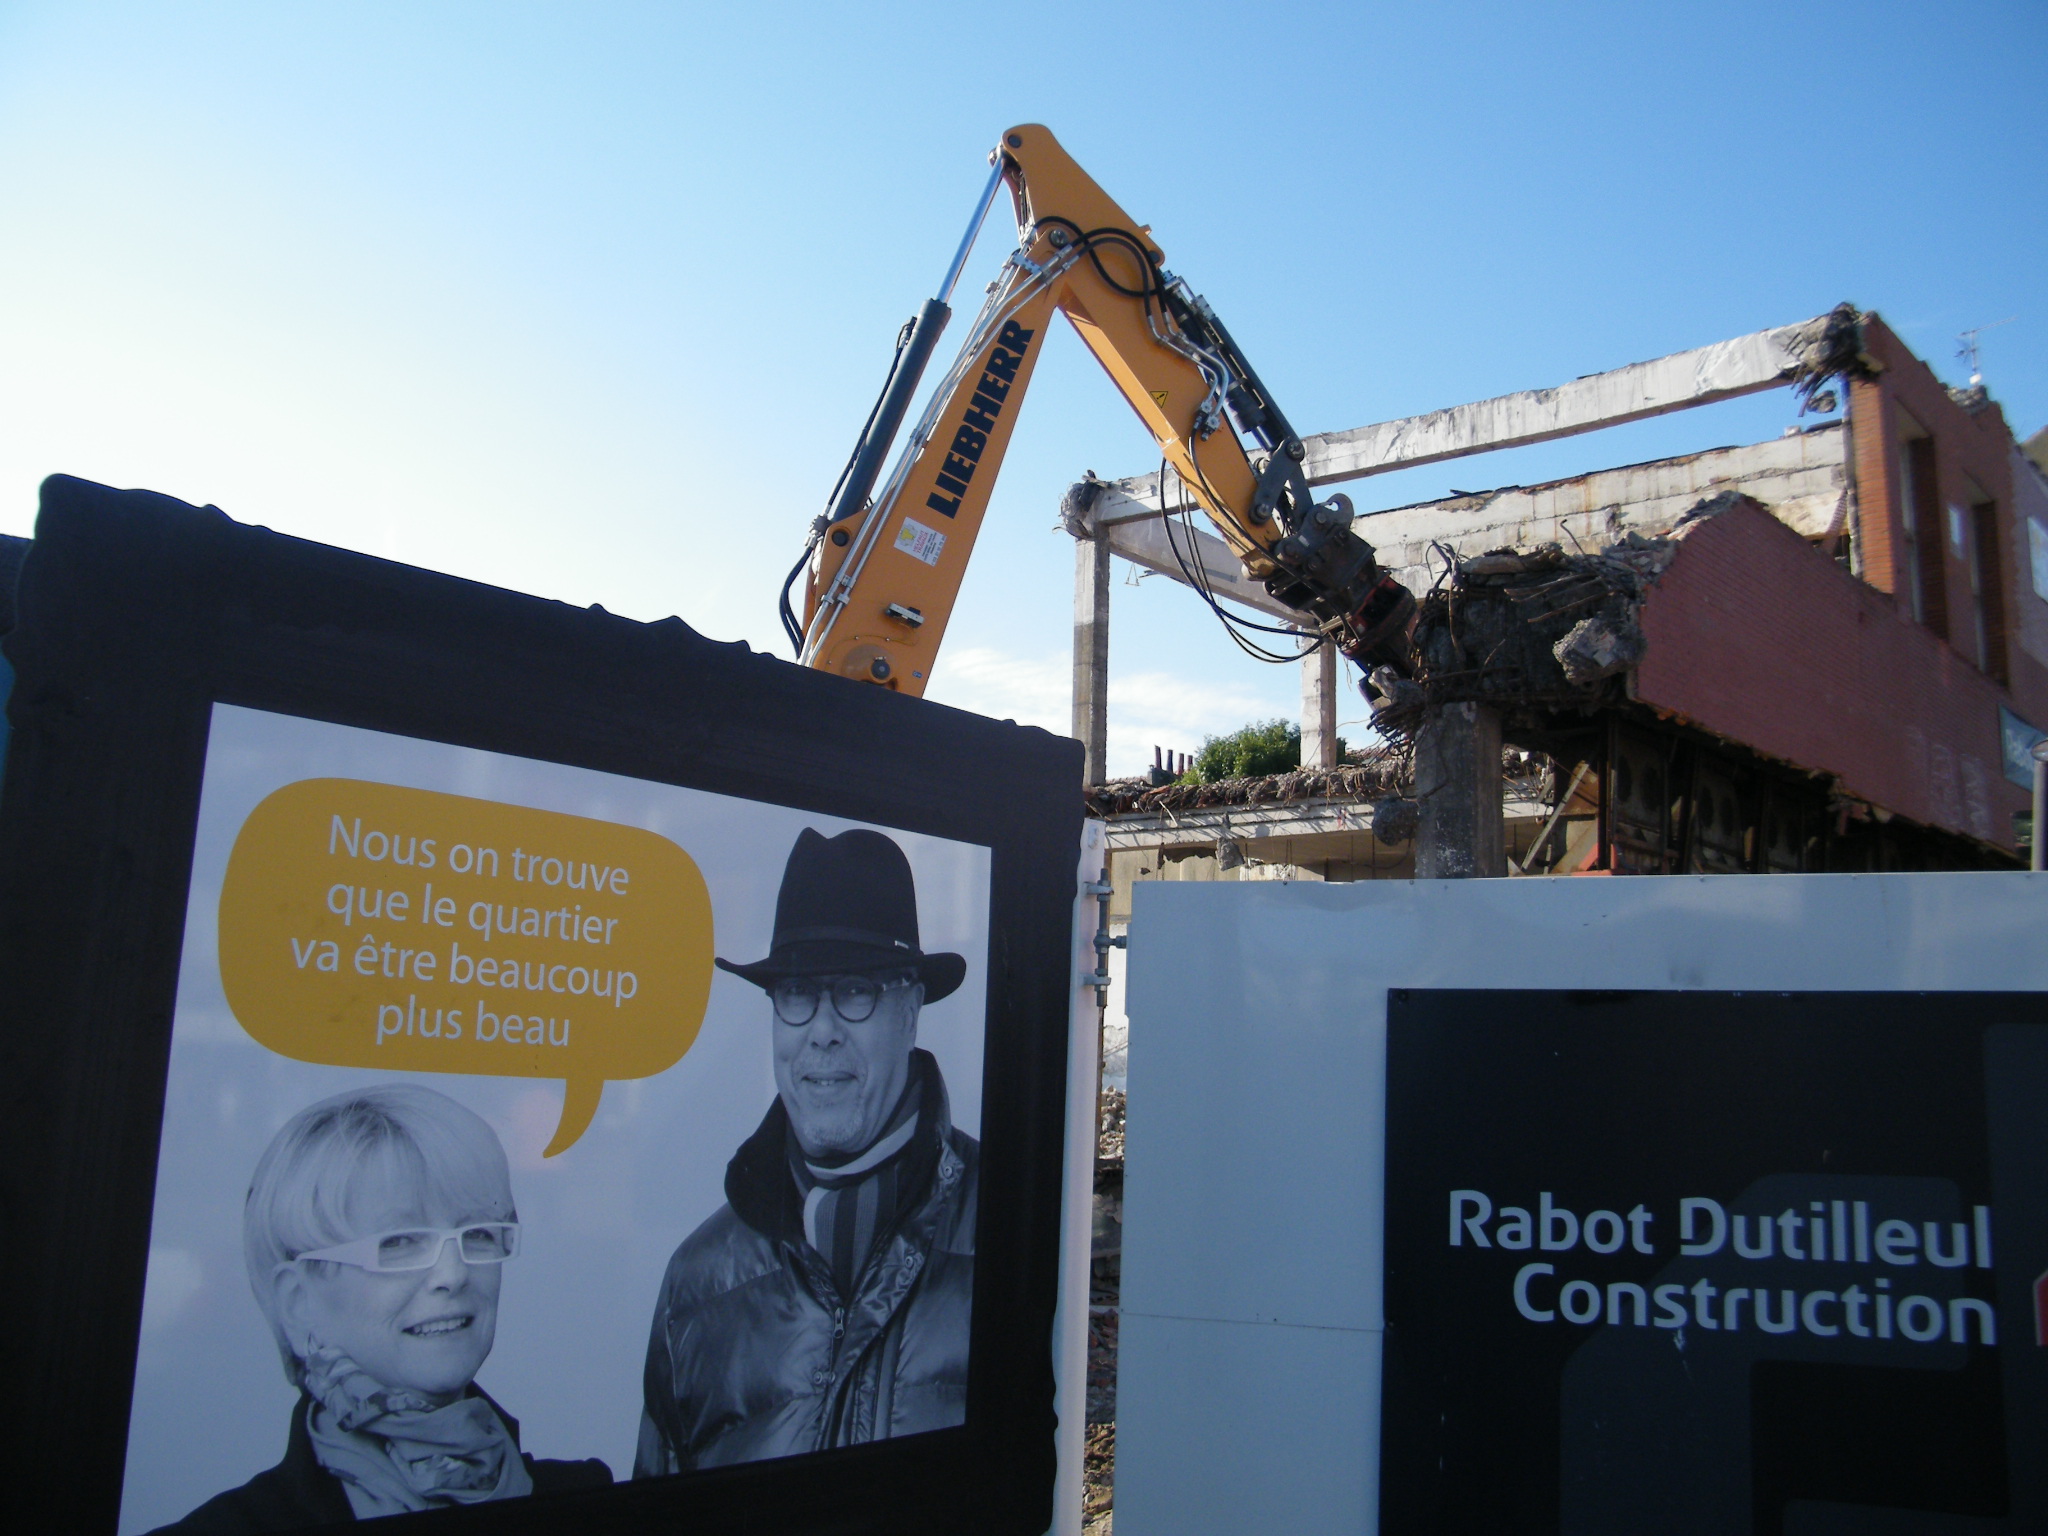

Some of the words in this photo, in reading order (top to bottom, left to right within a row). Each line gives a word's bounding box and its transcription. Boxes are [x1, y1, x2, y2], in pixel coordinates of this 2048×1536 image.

[926, 319, 1035, 519] LIEBHERR
[329, 815, 436, 869] Nous
[449, 844, 499, 877] on
[512, 847, 629, 895] trouve
[327, 883, 409, 926] que
[422, 883, 456, 927] le
[468, 902, 618, 945] quartier
[291, 938, 339, 972] va
[353, 934, 437, 982] être
[449, 943, 638, 1007] beaucoup
[376, 995, 462, 1045] plus
[475, 1000, 570, 1046] beau
[1449, 1189, 1654, 1255] Rabot
[1680, 1197, 1993, 1269] Dutilleul
[1513, 1262, 1997, 1345] Construction
